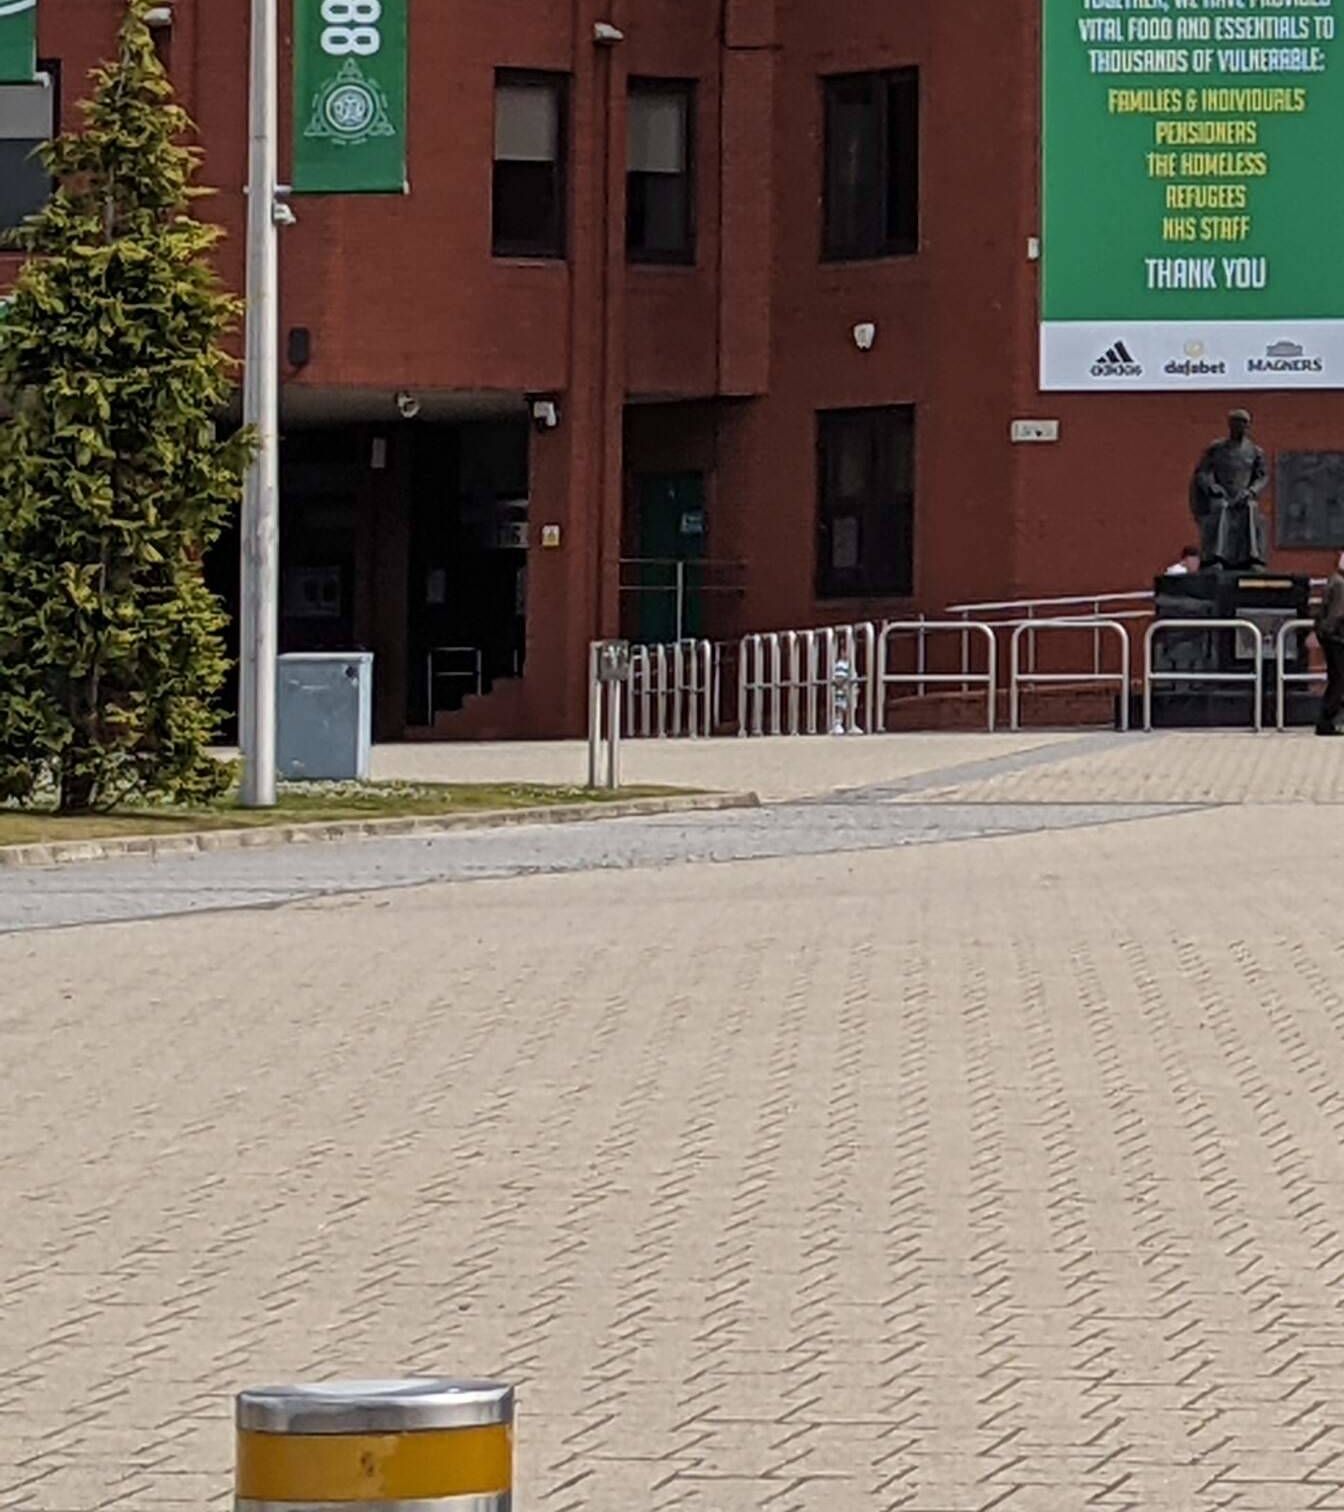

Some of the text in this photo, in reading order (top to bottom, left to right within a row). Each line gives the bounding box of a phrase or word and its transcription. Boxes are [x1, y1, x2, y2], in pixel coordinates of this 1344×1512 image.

[1078, 16, 1334, 42] VITAL FOOD AND ESSENTIALS TO
[1088, 47, 1325, 73] THOUSANDS OF VULNERABLE:
[1109, 88, 1306, 113] FAMILIES & INDIVIDUALS
[1156, 120, 1257, 144] PENSIONERS
[1146, 152, 1267, 177] THE HOMELESS
[1166, 184, 1247, 208] REFUGEES
[1163, 216, 1250, 240] NHS STAFF
[1145, 258, 1267, 288] THANK YOU
